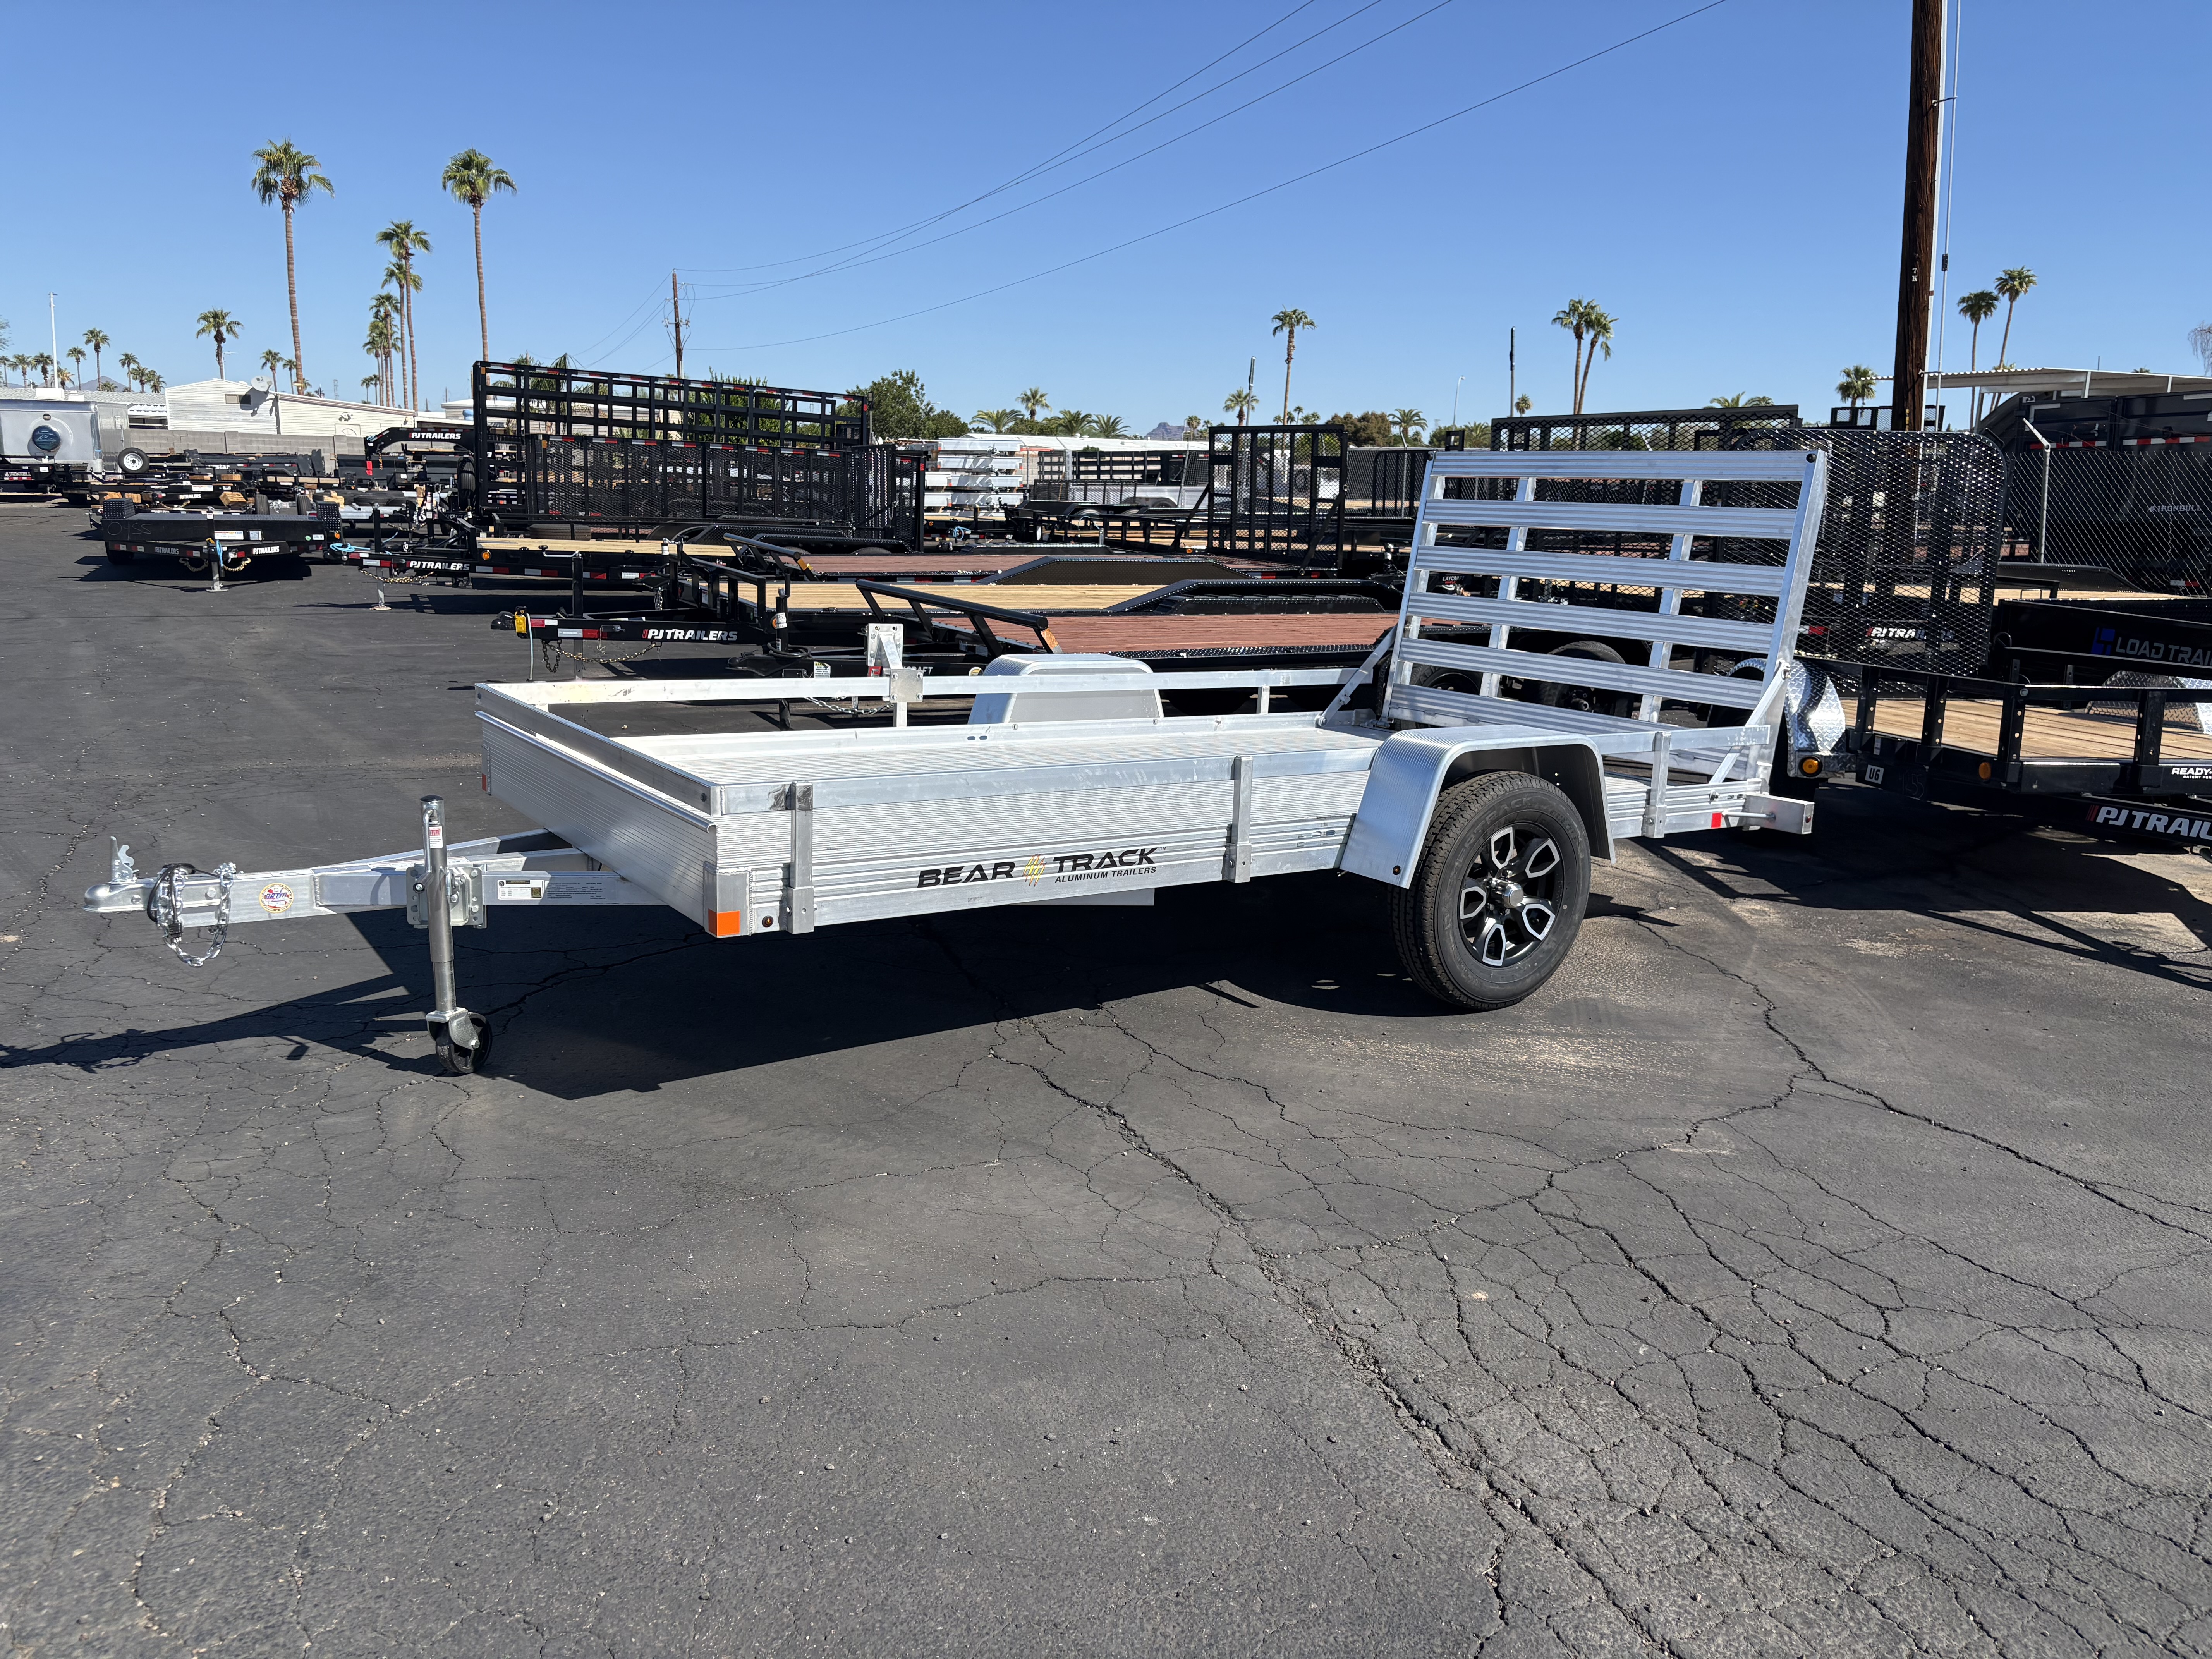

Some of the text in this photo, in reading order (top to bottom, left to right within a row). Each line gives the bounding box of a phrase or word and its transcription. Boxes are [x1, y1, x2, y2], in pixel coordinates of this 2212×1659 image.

[421, 562, 470, 571] TRAILERS
[647, 629, 737, 641] PJ TRAILERS
[2116, 637, 2164, 659] LOAD
[1869, 767, 1880, 781] U6
[2096, 806, 2129, 826] PJ
[917, 861, 1016, 888] BEAR
[1053, 847, 1158, 874] TRACK
[1055, 866, 1157, 883] ALUMINUM TRAILERS
